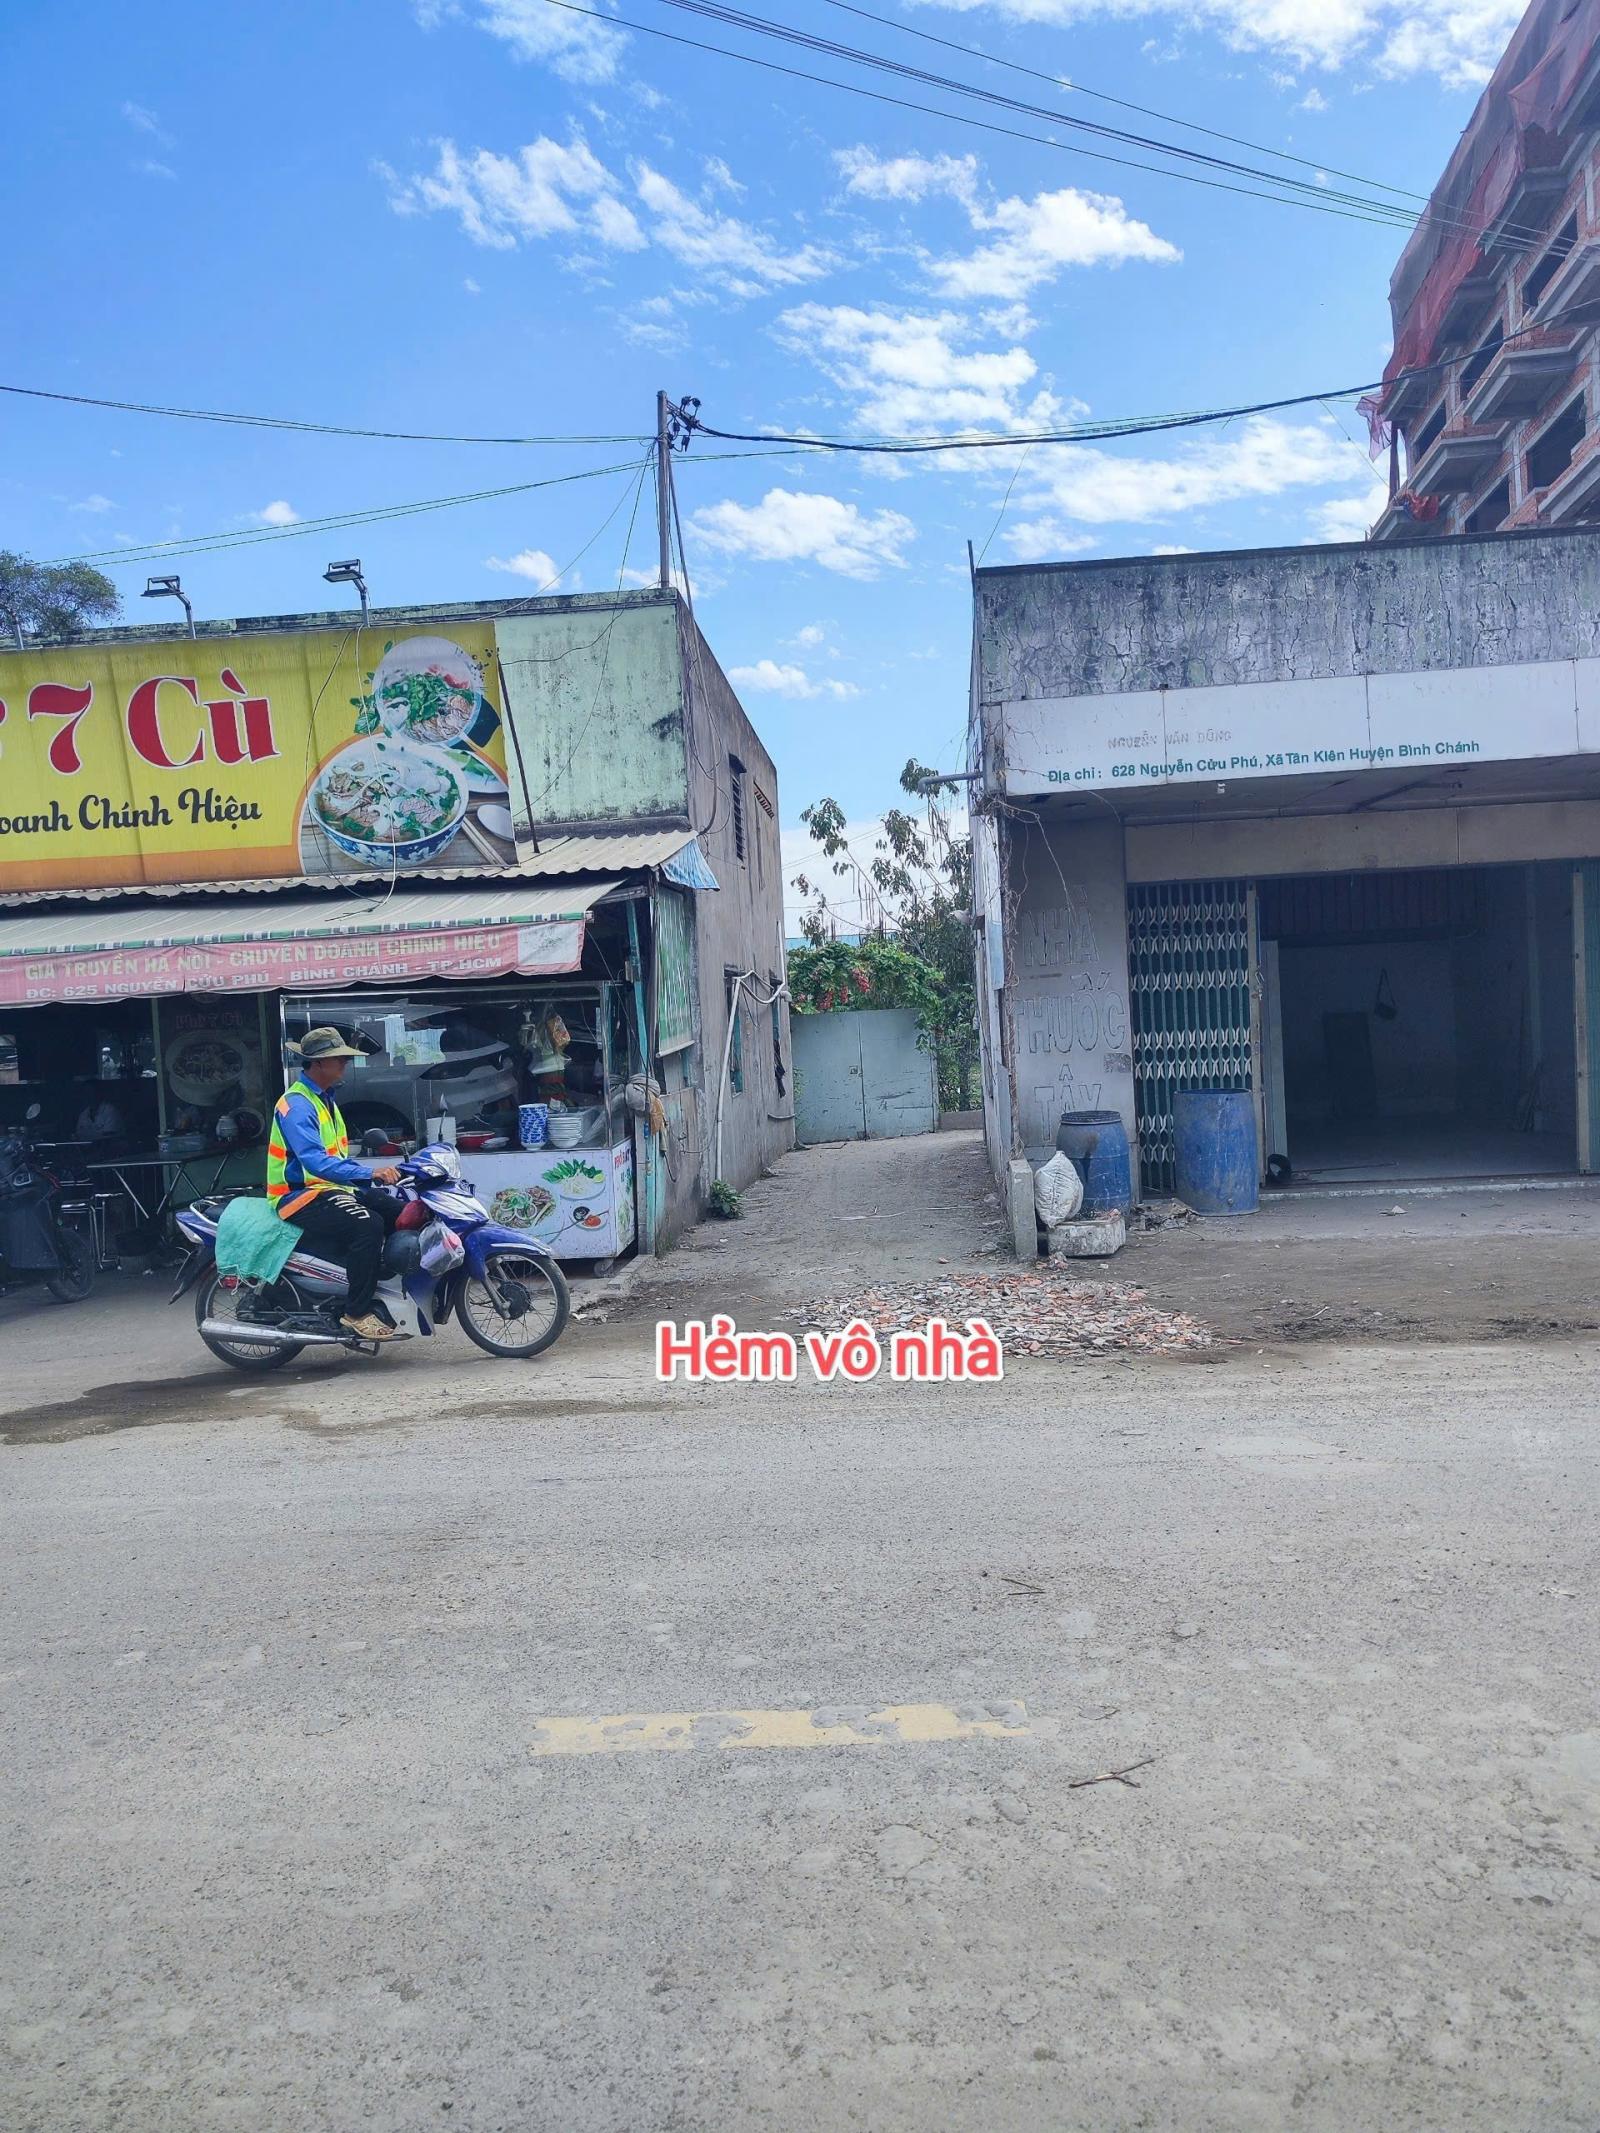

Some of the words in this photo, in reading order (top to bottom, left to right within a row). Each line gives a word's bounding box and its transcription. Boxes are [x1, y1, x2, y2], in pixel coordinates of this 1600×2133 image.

[27, 680, 93, 776] 7
[126, 667, 281, 770] Cù
[1112, 765, 1136, 777] 628
[1140, 759, 1194, 778] Nguyễn
[1266, 754, 1284, 767] Xã
[1349, 748, 1394, 762] Huyện
[1398, 744, 1431, 757] Bình
[1435, 740, 1480, 755] Chánh
[78, 793, 173, 832] Chính
[177, 787, 263, 831] Hiệu
[25, 964, 56, 981] GIA
[63, 985, 98, 997] 625
[231, 970, 270, 986] PHÚ
[289, 968, 337, 983] BÌNH
[342, 962, 409, 978] CHÁNH
